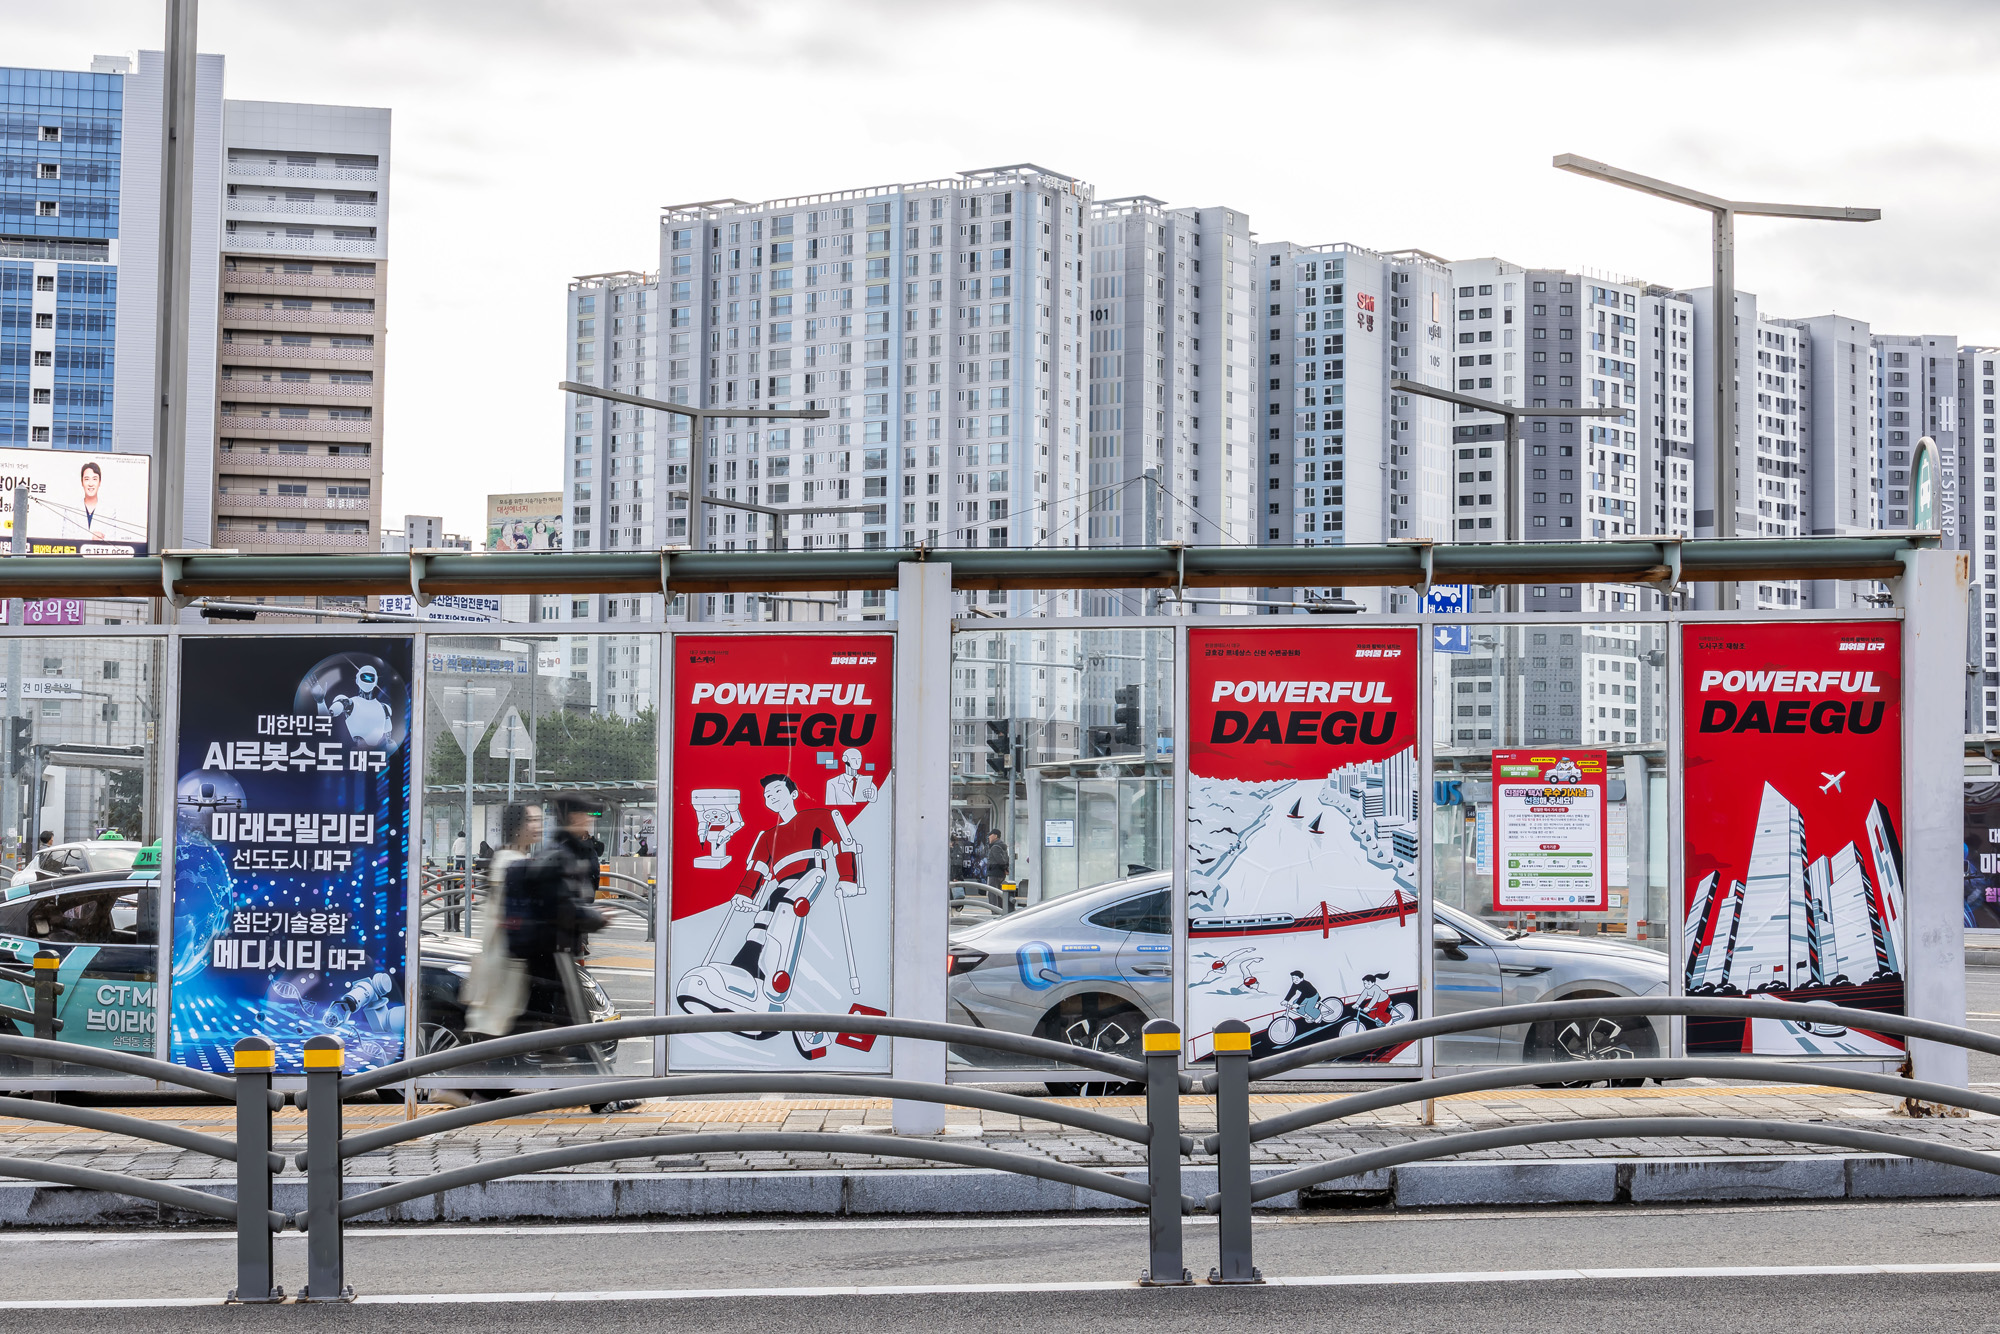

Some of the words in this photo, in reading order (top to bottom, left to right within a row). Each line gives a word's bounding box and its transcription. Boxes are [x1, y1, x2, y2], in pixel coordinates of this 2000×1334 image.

[1357, 291, 1375, 312] SM
[1090, 309, 1108, 321] 101
[1357, 312, 1374, 333] 우방
[1429, 355, 1441, 367] 105
[496, 504, 529, 515] 대성에너지
[23, 600, 80, 622] 성의원
[1383, 649, 1401, 657] 대구
[1867, 642, 1885, 651] 대구
[859, 656, 877, 665] 대구
[1211, 680, 1393, 703] POWERFUL
[1700, 670, 1881, 693] POWERFUL
[691, 682, 873, 706] POWERFUL
[258, 715, 333, 736] 대한민국
[1210, 710, 1397, 745] DAEGU
[1699, 700, 1886, 734] DAEGU
[689, 712, 878, 747] DAEGU
[202, 742, 344, 772] AI로봇수도
[350, 751, 387, 772] 대구
[1527, 788, 1543, 797] 택시
[1544, 788, 1561, 797] 우수
[211, 812, 375, 844] 미래모빌리티
[232, 849, 308, 871] 선도도시
[314, 850, 352, 871] 대구
[233, 912, 348, 934] 첨단기술융합
[213, 939, 322, 970] 메디시티
[328, 949, 366, 970] 대구
[113, 1035, 140, 1048] 삼덕동
